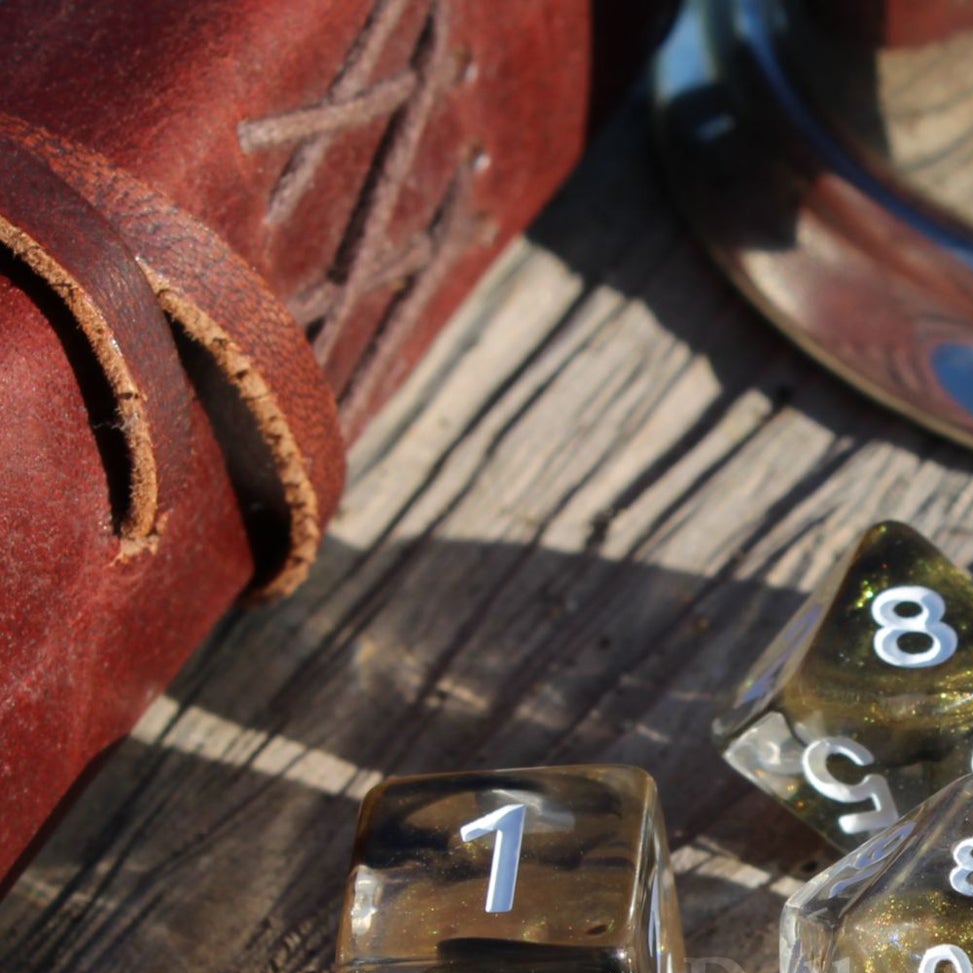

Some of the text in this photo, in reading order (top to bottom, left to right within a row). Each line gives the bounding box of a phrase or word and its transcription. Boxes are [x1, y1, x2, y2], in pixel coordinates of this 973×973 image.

[871, 585, 959, 668] 8
[802, 736, 899, 834] 5
[460, 804, 527, 913] 1
